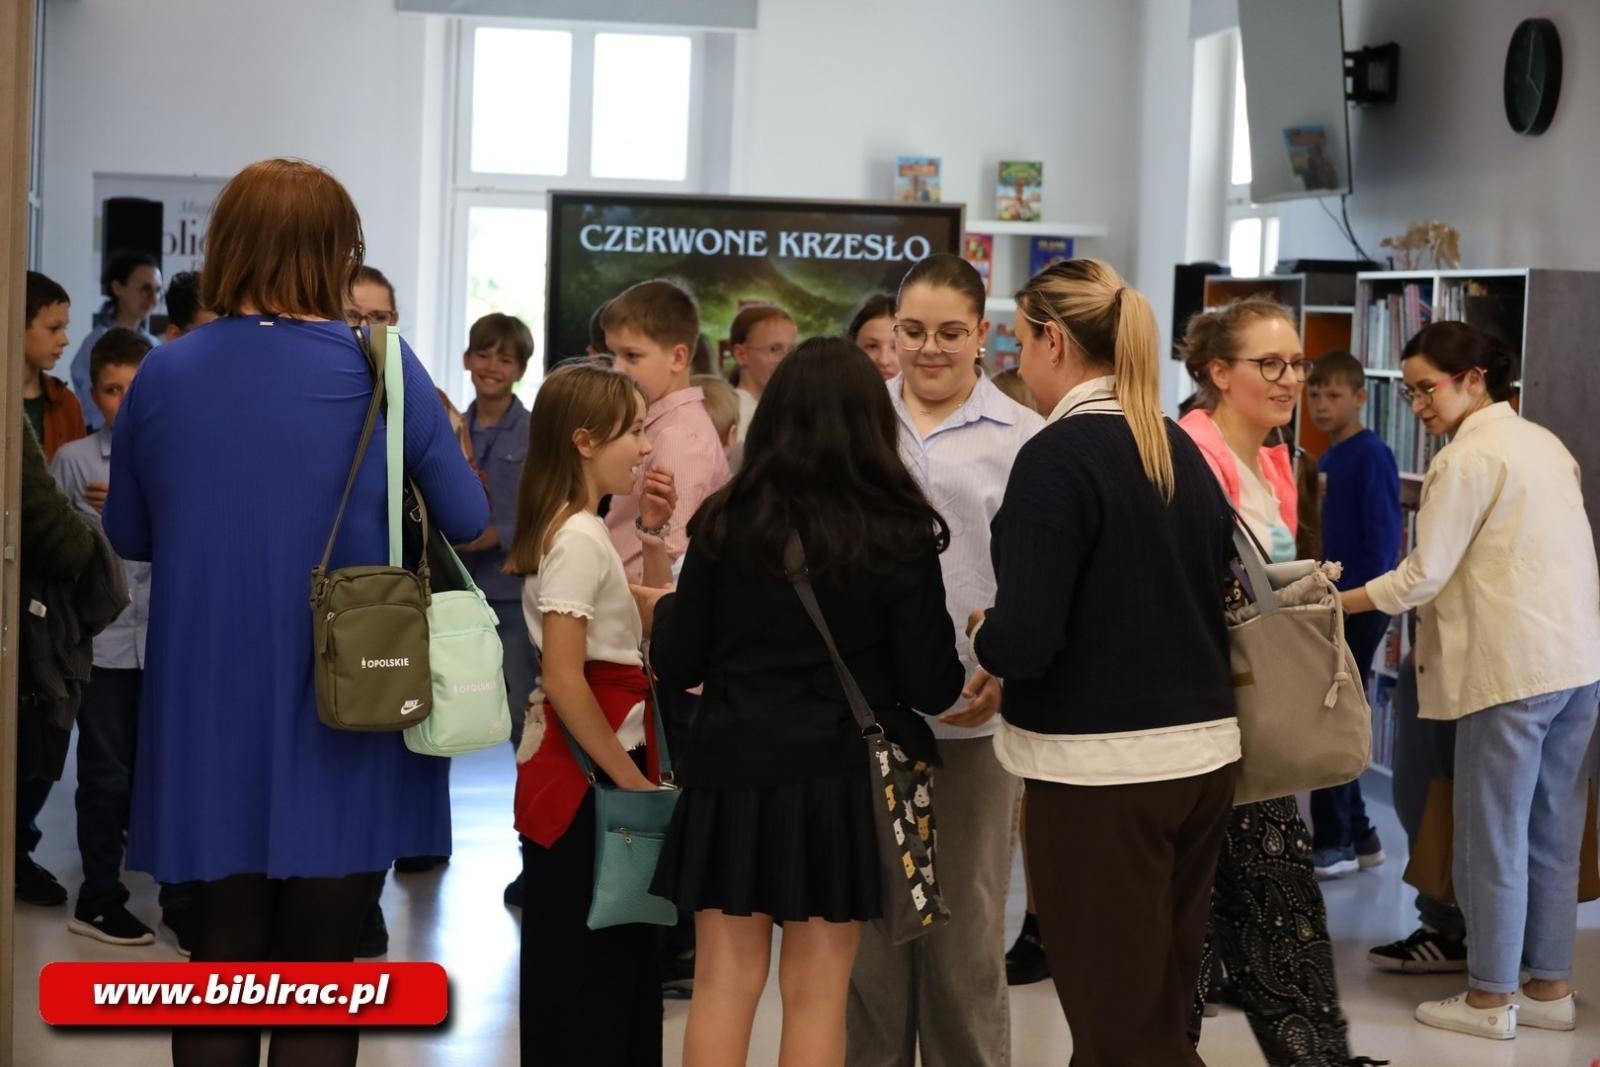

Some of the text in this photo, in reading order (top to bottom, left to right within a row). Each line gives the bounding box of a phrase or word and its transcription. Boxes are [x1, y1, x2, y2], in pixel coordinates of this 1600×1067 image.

[579, 224, 931, 263] CZERWONE KRZESŁO
[367, 657, 410, 669] OPOLSKIE
